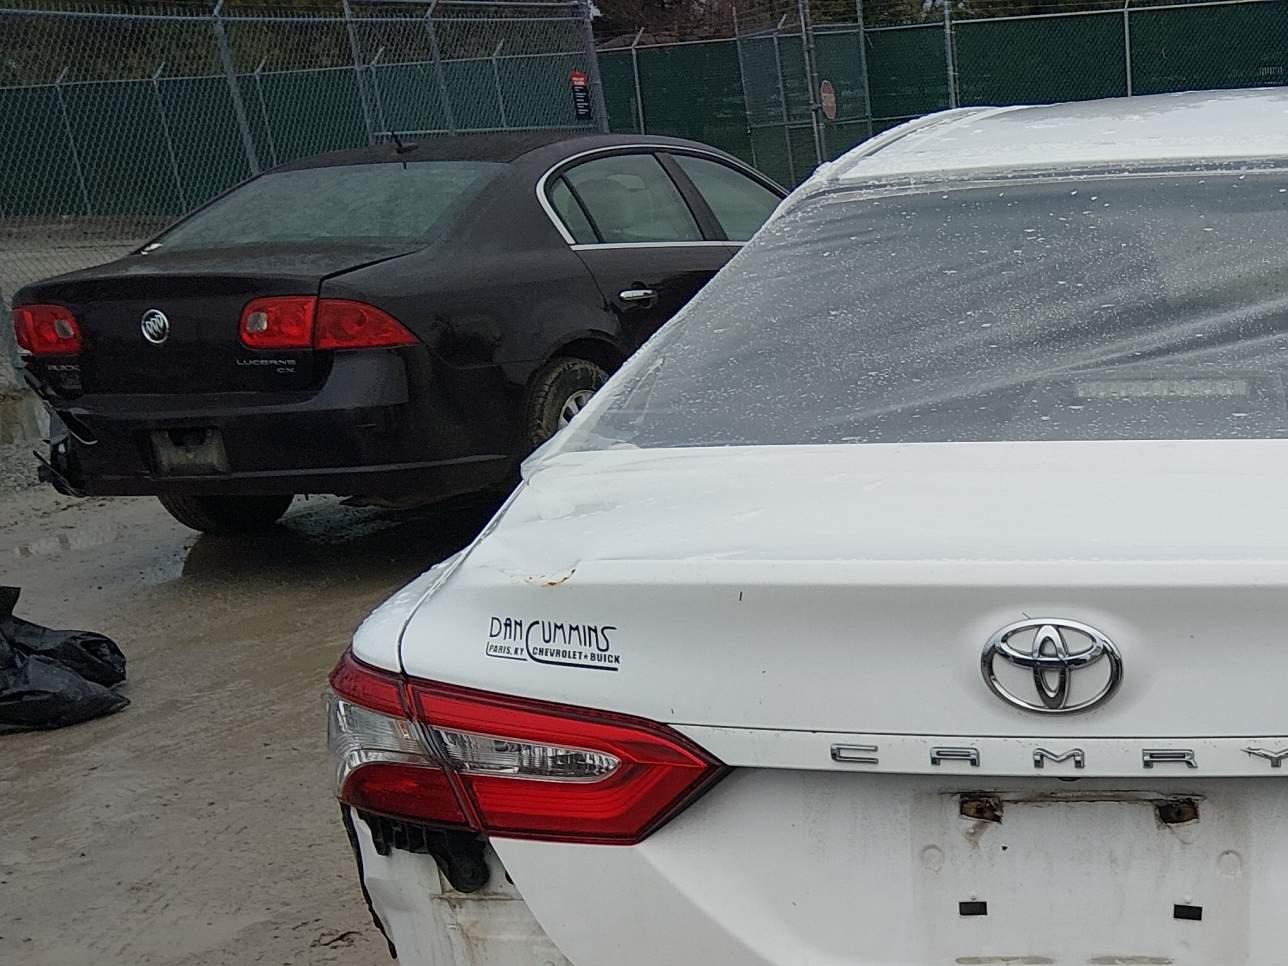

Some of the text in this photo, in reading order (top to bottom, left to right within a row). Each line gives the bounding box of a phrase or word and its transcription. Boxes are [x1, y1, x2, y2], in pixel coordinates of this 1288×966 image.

[489, 616, 618, 662] DAN CUMMINS
[514, 646, 525, 657] KY
